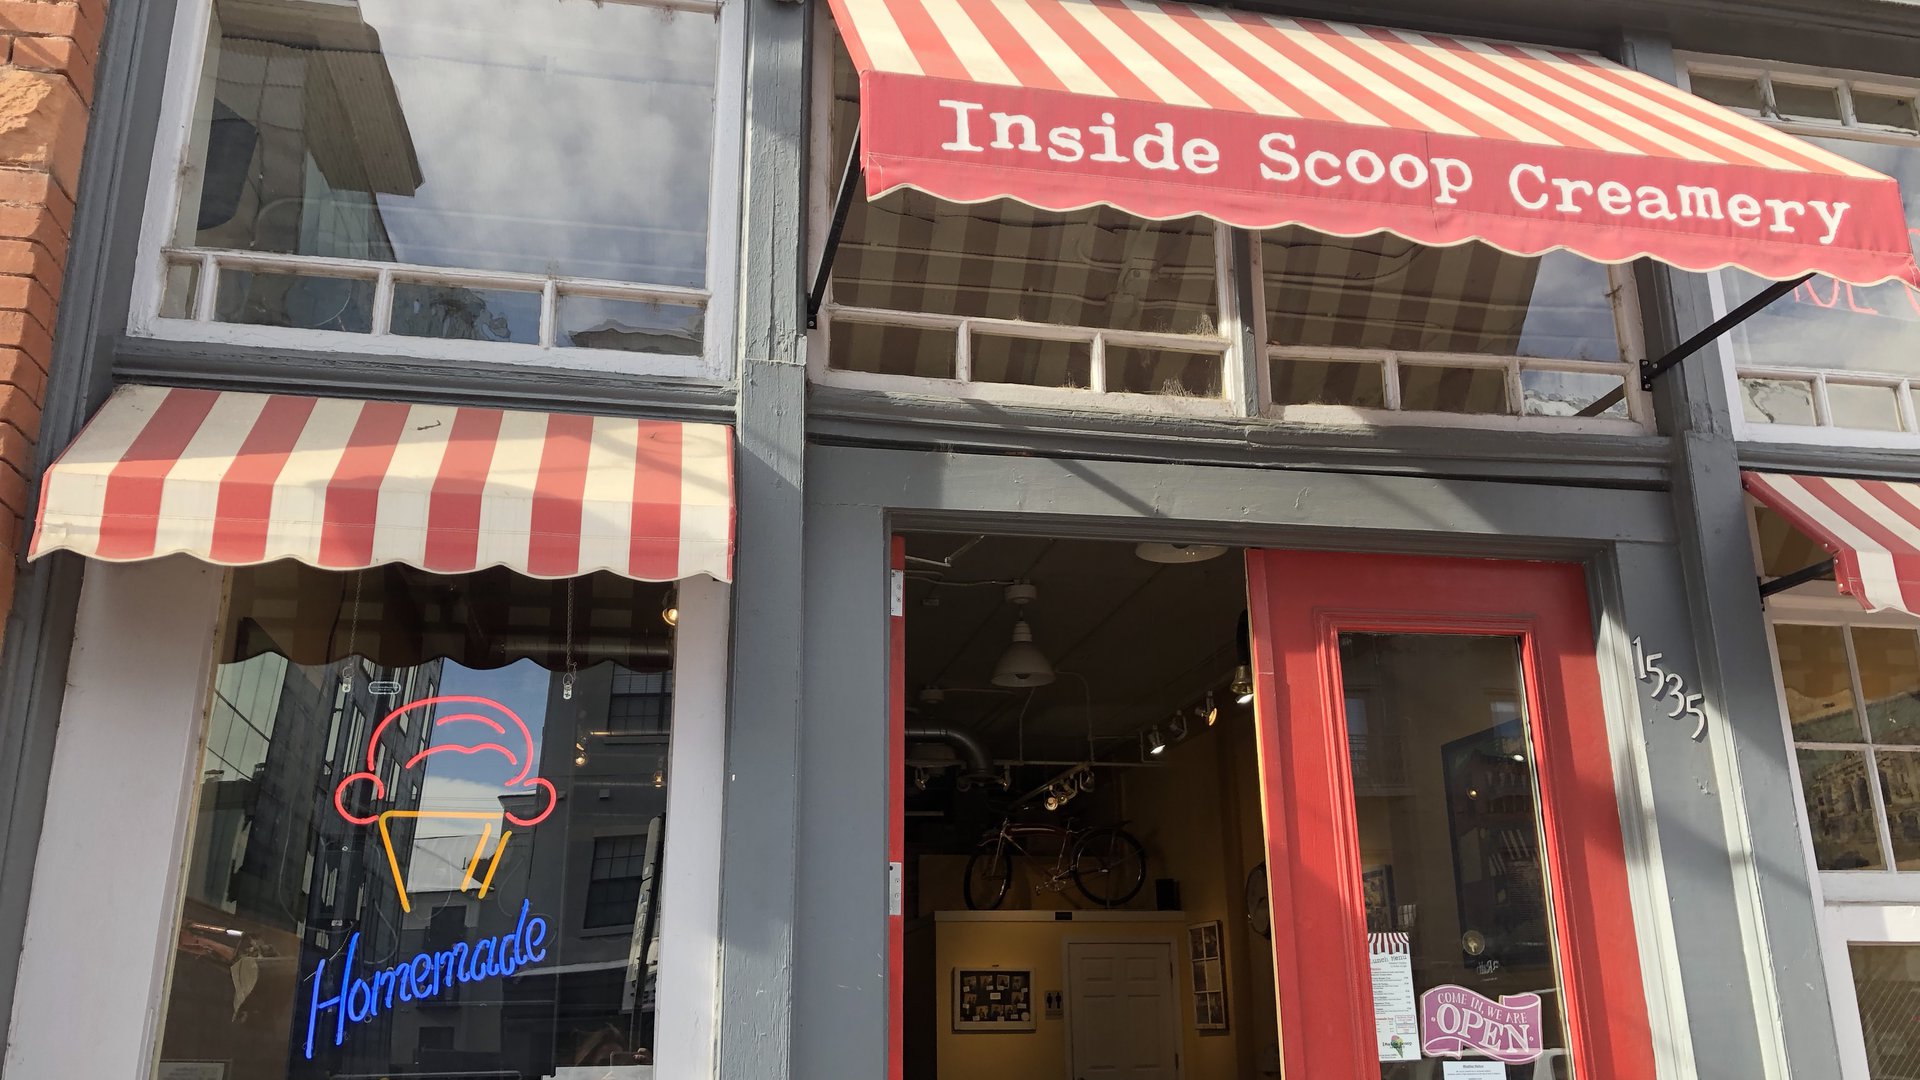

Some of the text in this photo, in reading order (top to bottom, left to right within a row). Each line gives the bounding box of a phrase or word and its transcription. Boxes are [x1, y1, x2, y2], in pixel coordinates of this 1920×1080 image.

[939, 99, 1851, 245] Inside Scoop Creamery
[1632, 635, 1705, 740] 1535
[304, 898, 547, 1060] Homemade
[1436, 1003, 1530, 1053] OPEN
[1437, 992, 1528, 1024] COME IN, WE ARE
